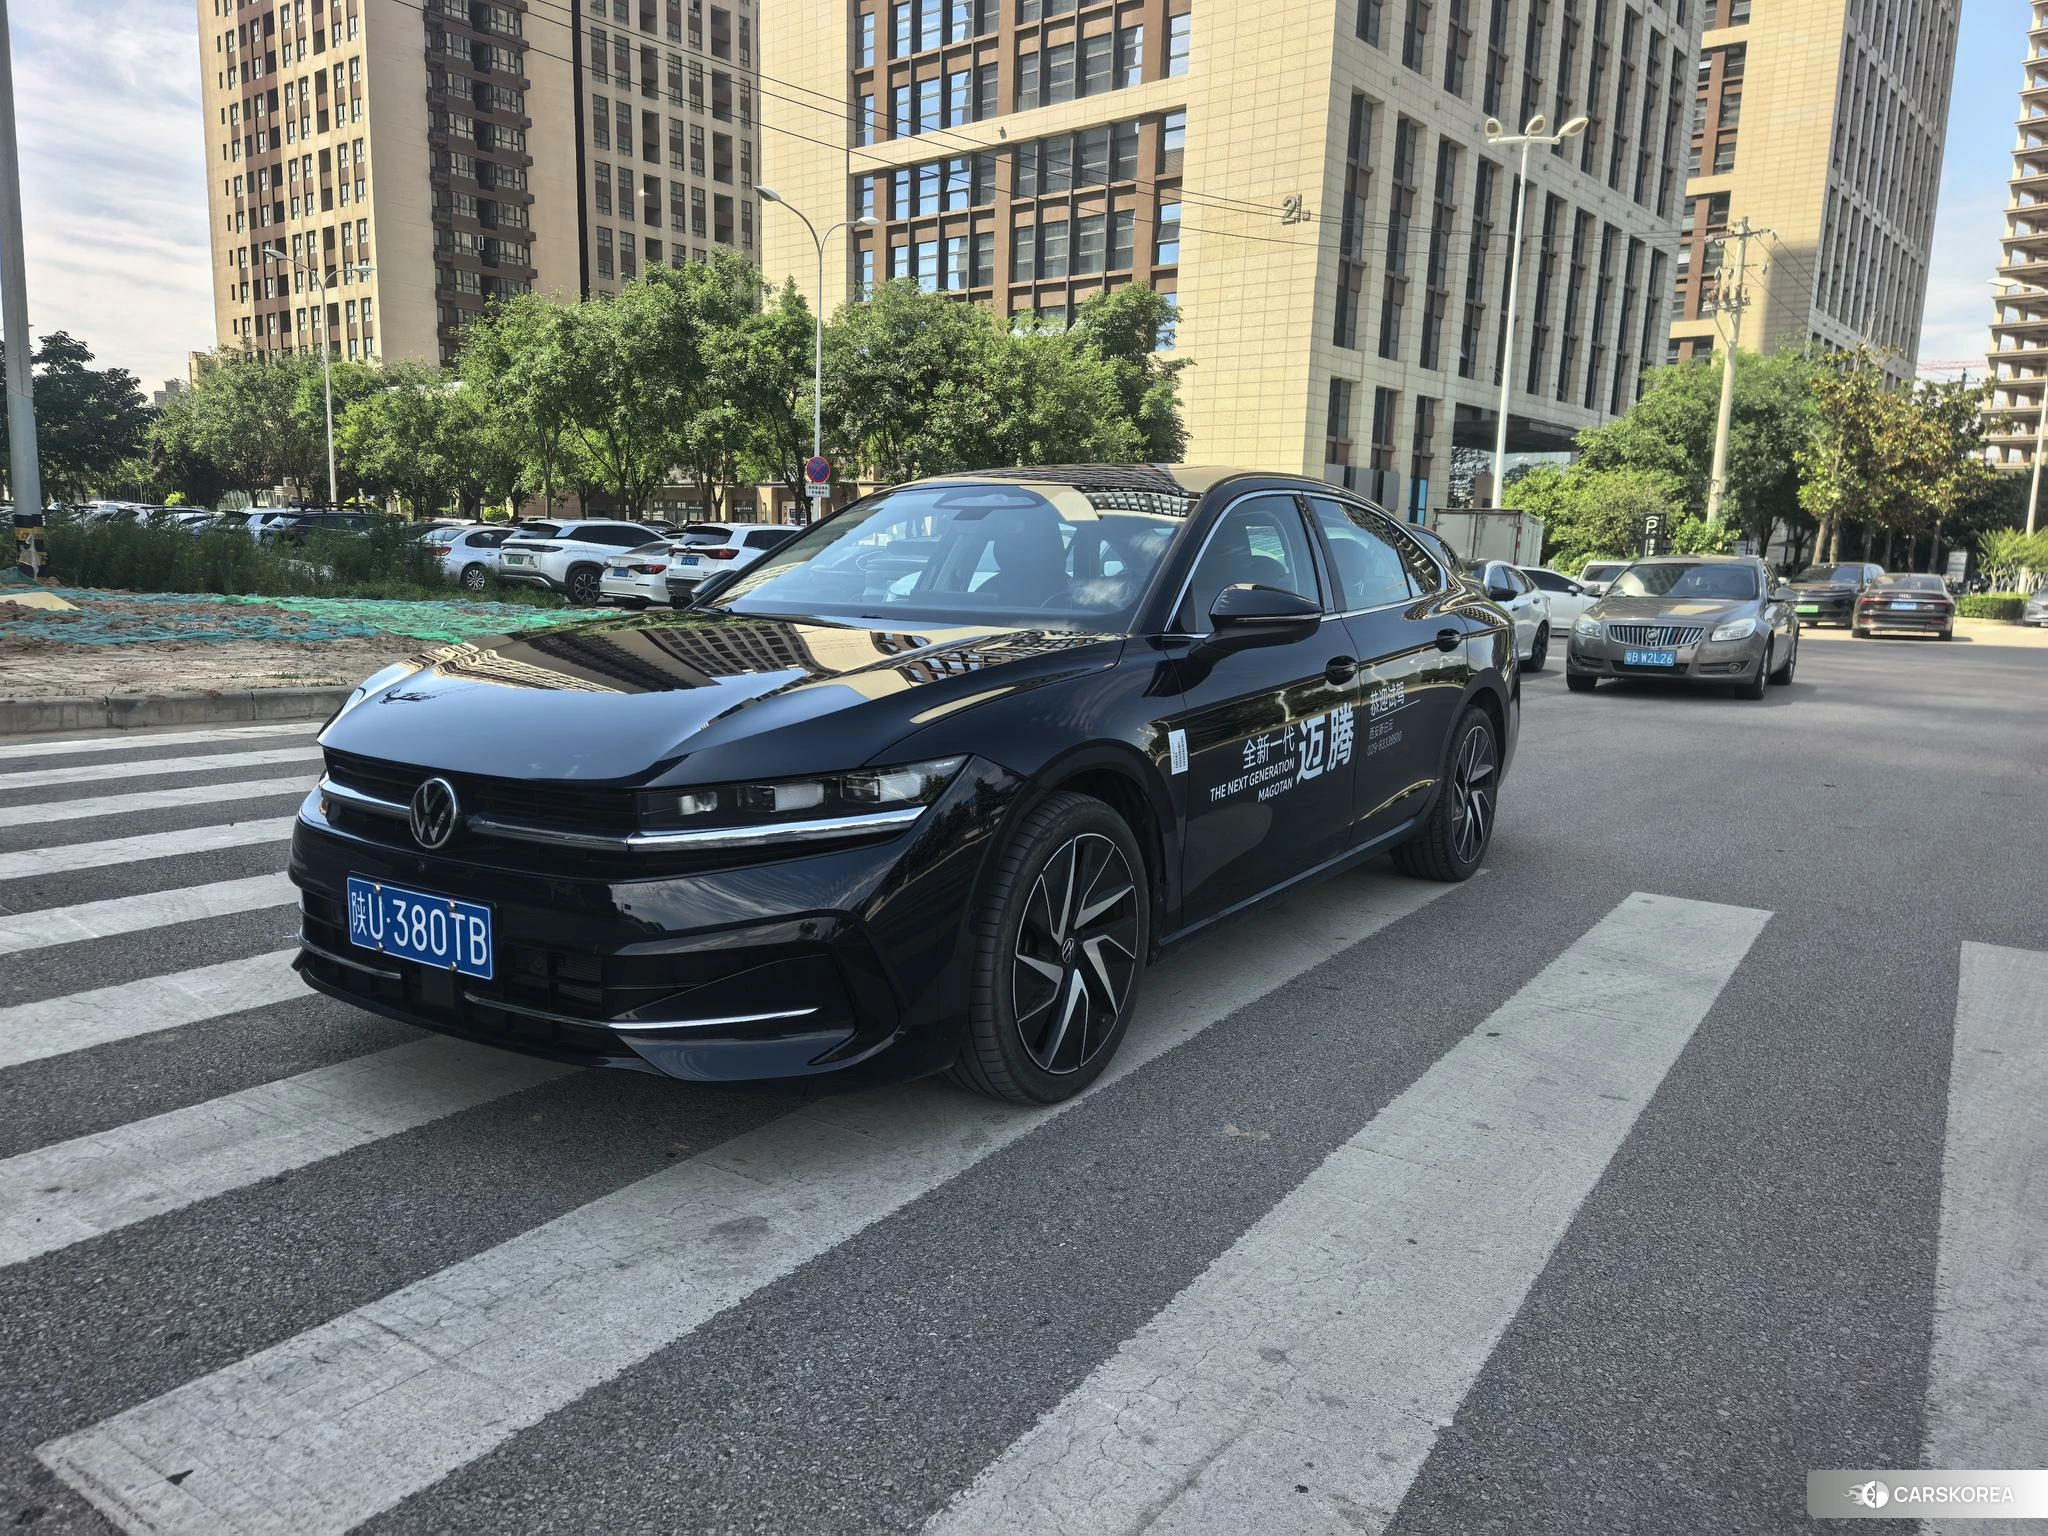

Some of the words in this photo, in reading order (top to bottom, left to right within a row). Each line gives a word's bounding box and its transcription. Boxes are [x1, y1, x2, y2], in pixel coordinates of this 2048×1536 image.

[1645, 519, 1658, 535] P
[1369, 681, 1405, 716] 恭迎试驾
[1242, 725, 1295, 769] 全新一代
[1296, 702, 1354, 785] 迈腾
[1210, 783, 1227, 802] THE
[1227, 775, 1249, 796] NEXT
[1249, 756, 1295, 786] GENERATION
[1257, 776, 1293, 803] MAGOTAN
